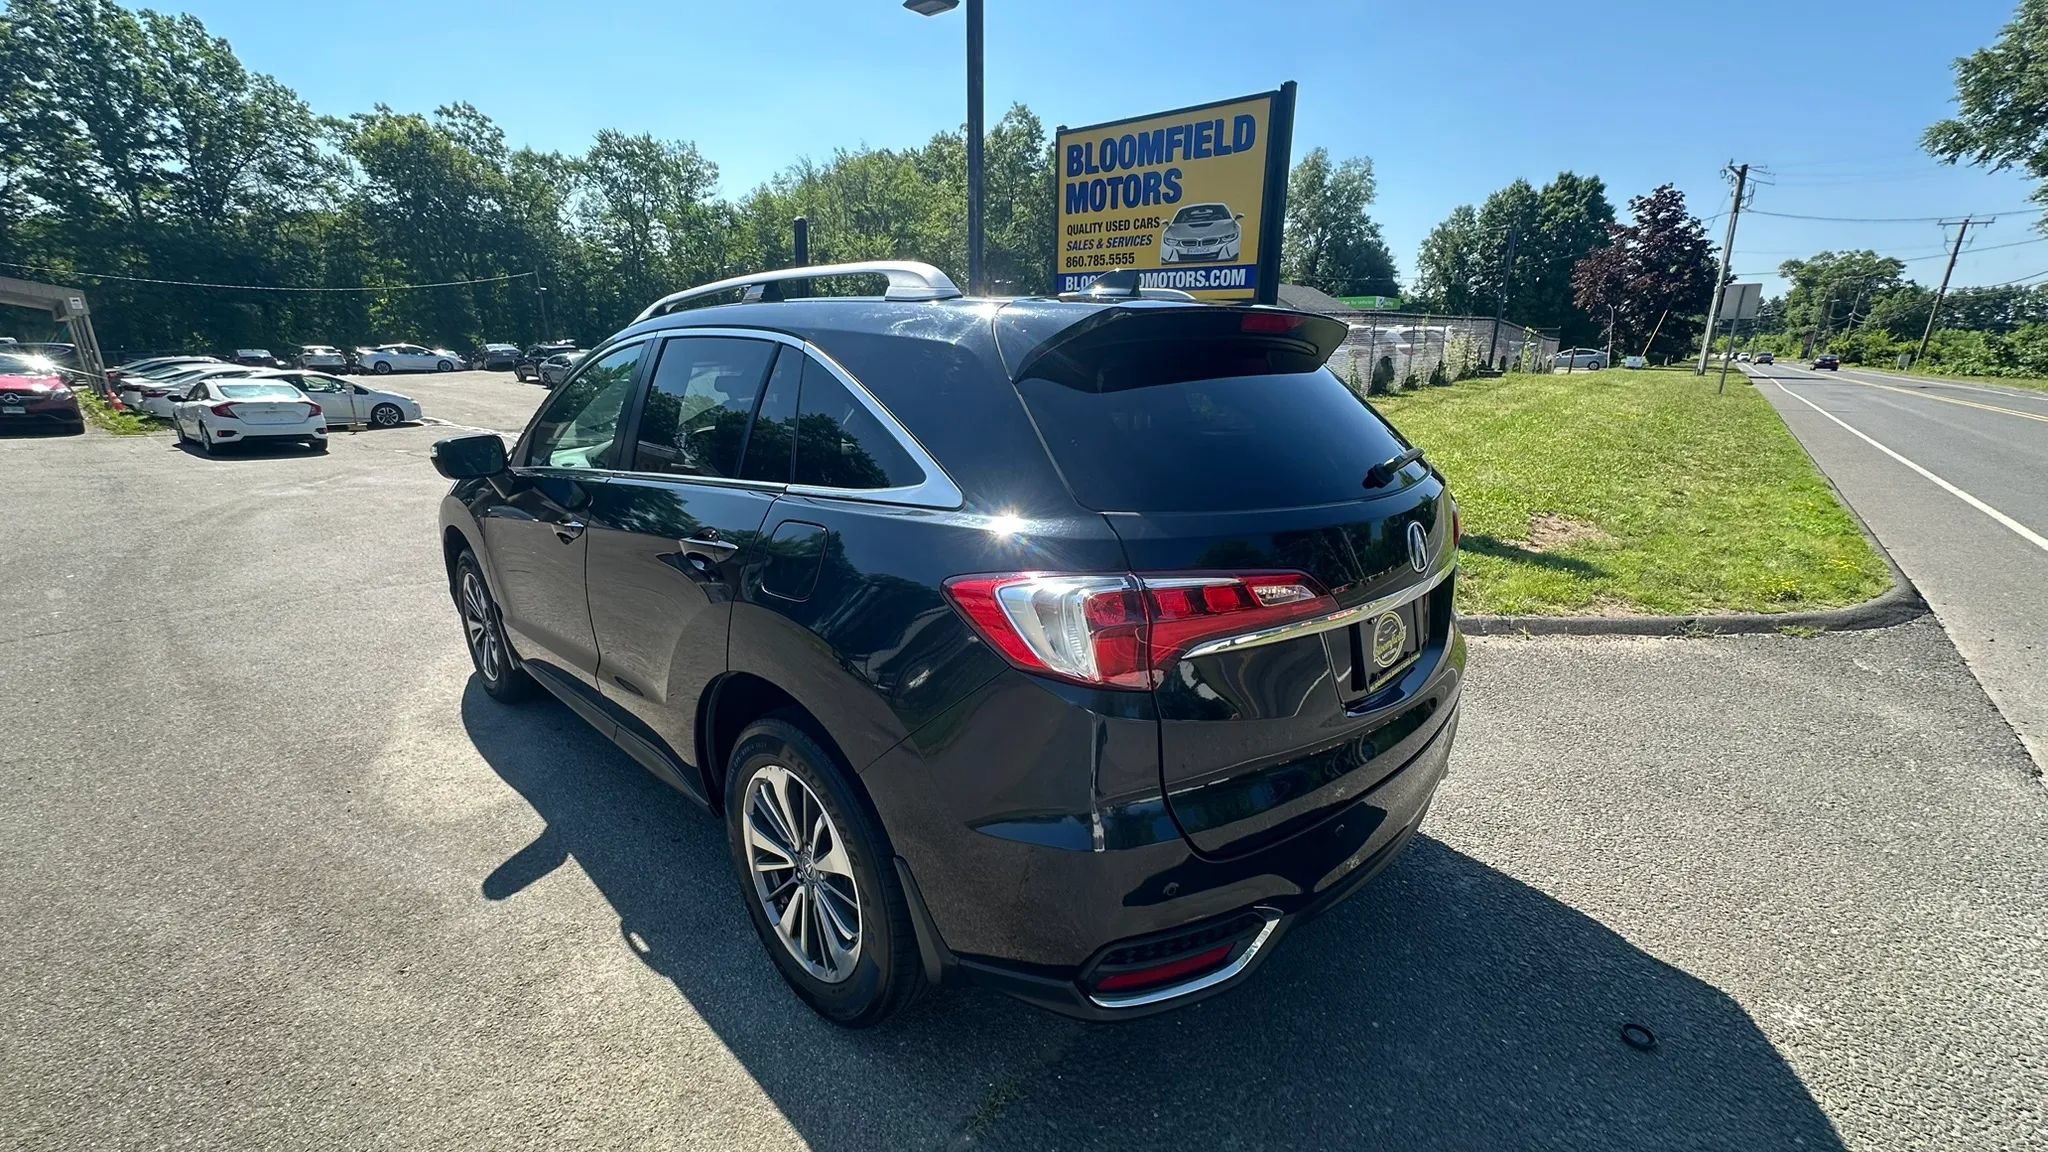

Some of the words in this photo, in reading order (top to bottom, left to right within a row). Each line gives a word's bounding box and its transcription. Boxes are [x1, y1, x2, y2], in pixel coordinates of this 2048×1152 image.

[1066, 114, 1256, 177] BLOOMFIELD
[1065, 167, 1183, 215] MOTORS
[1067, 222, 1103, 236] QUALITY
[1106, 219, 1130, 232] USED
[1134, 216, 1160, 230] CARS
[1066, 238, 1094, 252] SALES
[1096, 238, 1104, 249] &
[1106, 234, 1153, 249] SERVICES
[1066, 252, 1135, 268] 860.785.5555
[1065, 268, 1246, 292] BLOMOTORS.COM
